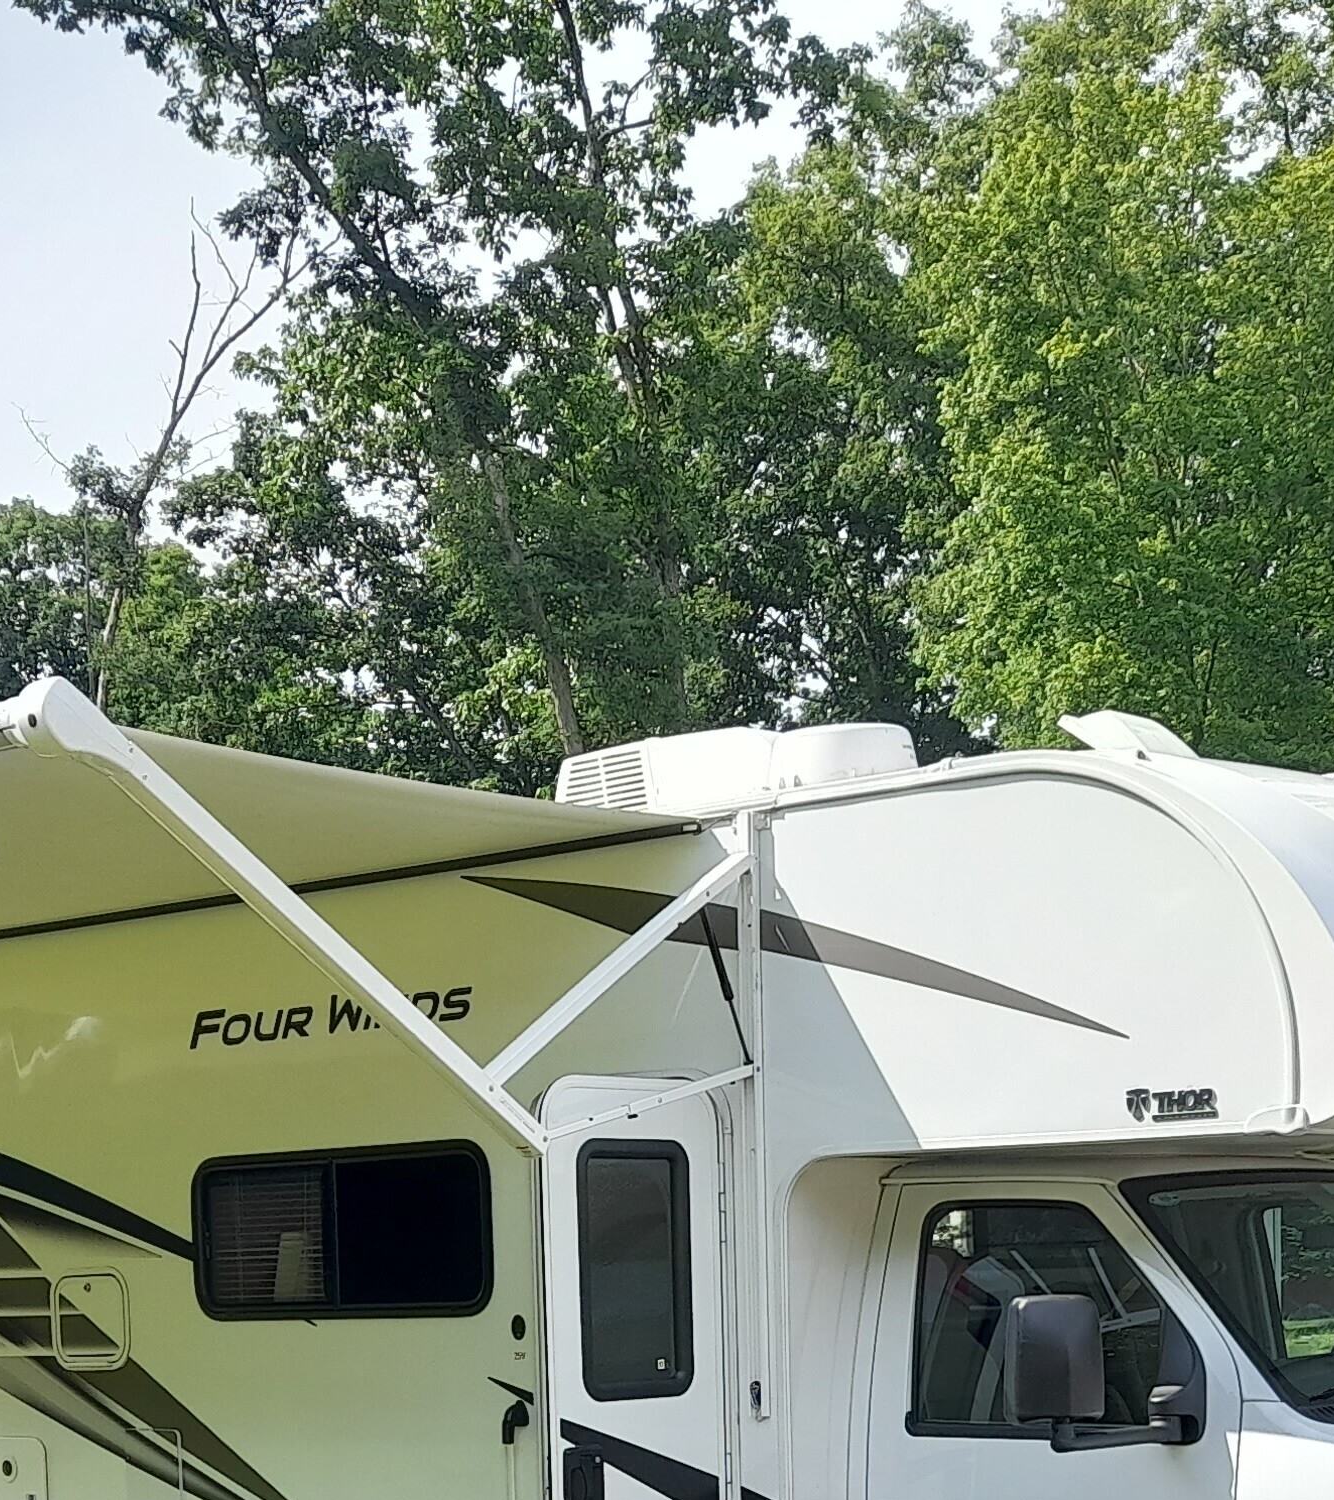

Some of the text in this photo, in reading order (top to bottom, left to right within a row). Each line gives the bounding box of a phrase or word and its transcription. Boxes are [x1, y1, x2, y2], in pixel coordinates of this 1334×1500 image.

[189, 986, 473, 1050] FOUR WDS
[1152, 1088, 1217, 1113] THOR
